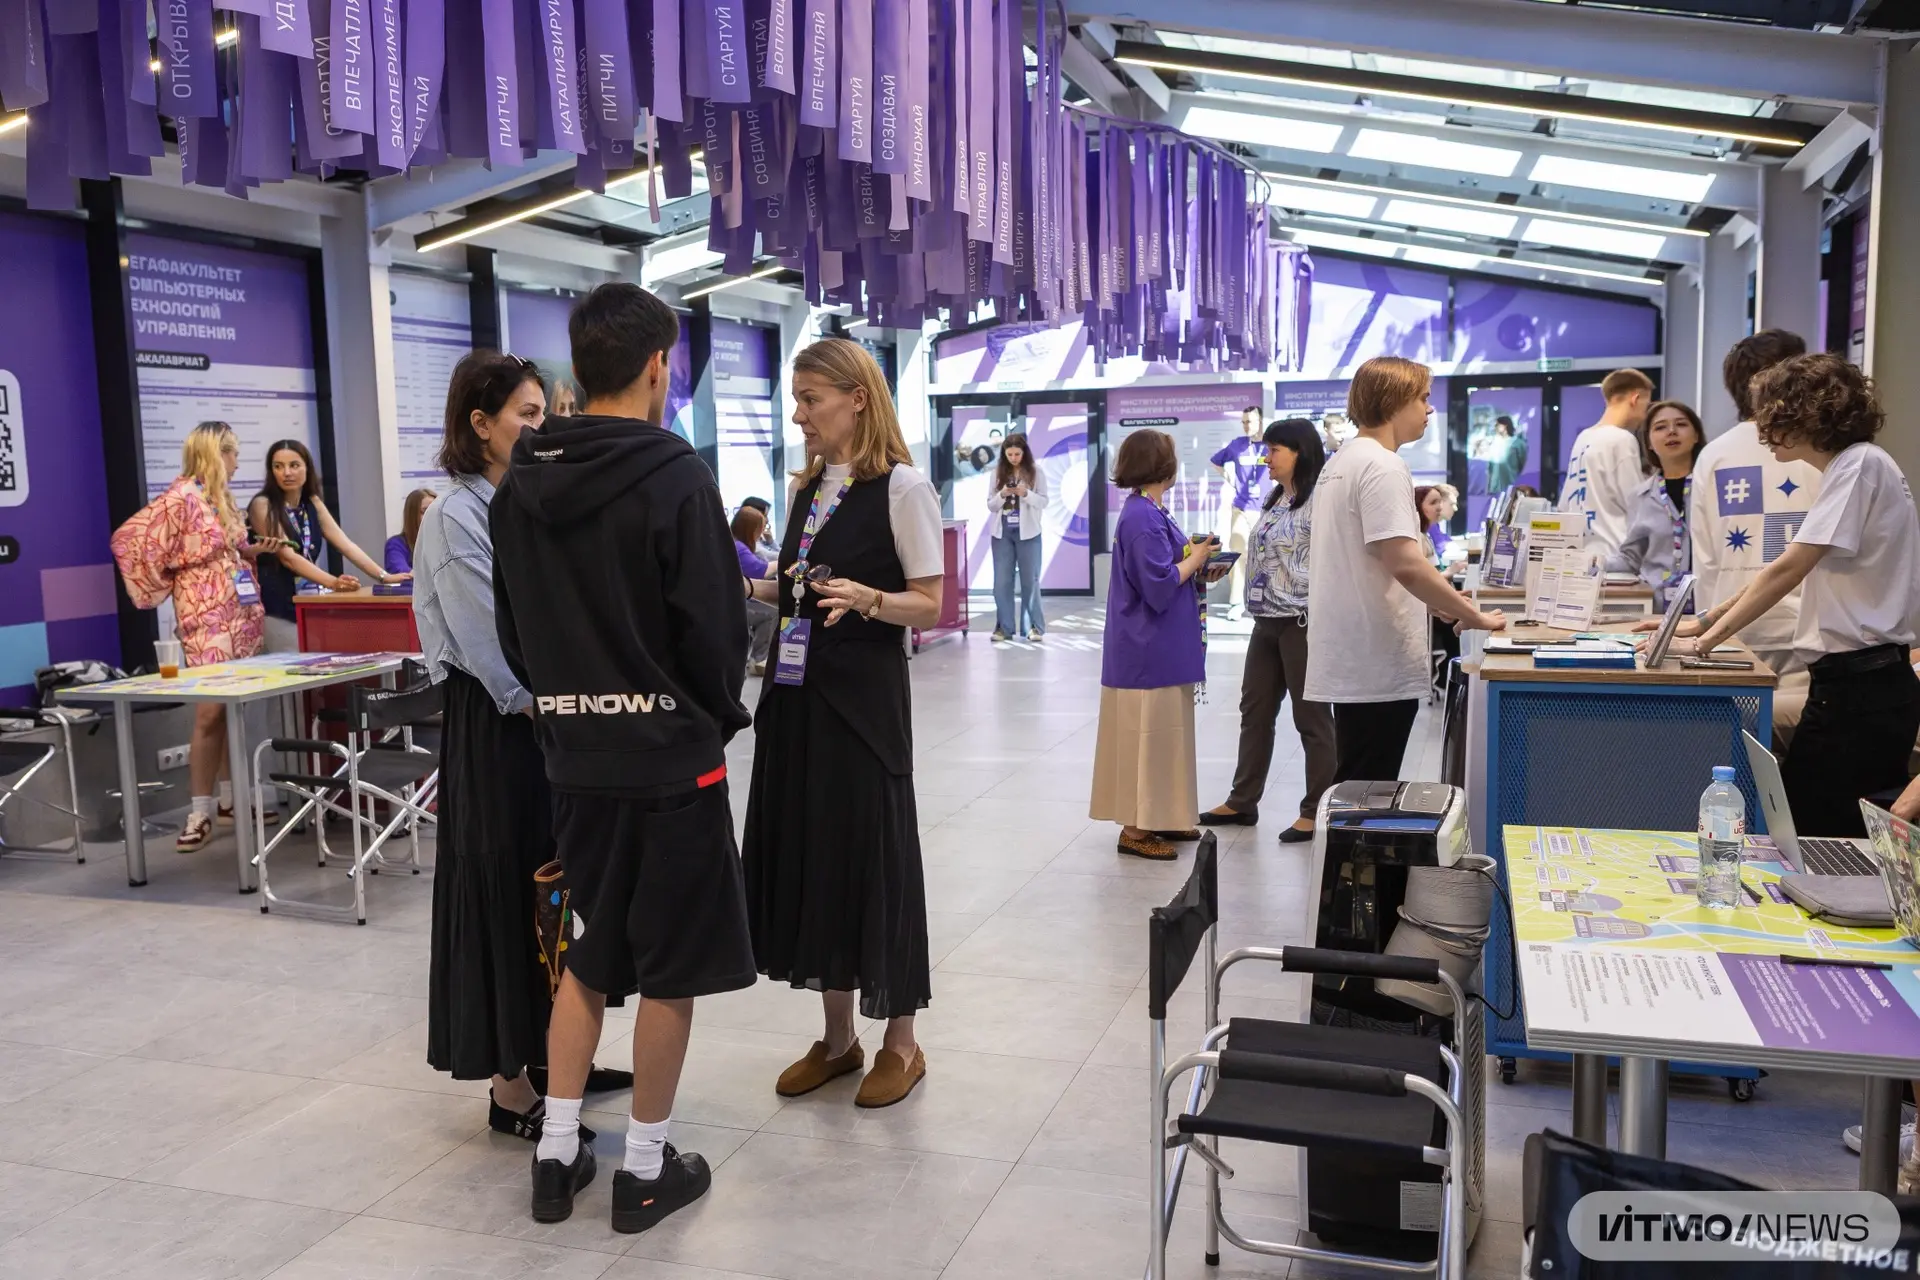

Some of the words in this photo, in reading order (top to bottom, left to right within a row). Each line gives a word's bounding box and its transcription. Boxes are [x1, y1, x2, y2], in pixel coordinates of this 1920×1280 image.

[718, 6, 735, 86] СТАРТУЙ
[812, 11, 826, 112] ВПЕЧАТЛЯЙ
[498, 76, 512, 147] ПИТЧИ
[600, 54, 618, 122] ПИТЧИ
[851, 77, 864, 149] СТАРТУЙ
[881, 74, 896, 160] СОЗДАВАЙ
[911, 104, 923, 185] УМНОЖАЙ
[959, 140, 967, 201] ПРОБУЙ
[976, 151, 988, 229] УПРАВЛЯЙ
[1000, 161, 1010, 252] ВЛЮБЛЯЙСЯ
[129, 276, 246, 302] ОМПЬЮТЕРНЫХ
[130, 255, 242, 282] ЕГАФАКУЛЬТЕТ
[969, 240, 977, 292] ДЕЙСТВ
[131, 298, 221, 319] ЕХНОЛОГИЙ
[136, 319, 236, 340] УПРАВЛЕНИЯ
[135, 352, 206, 367] АКАЛАВРИАТ
